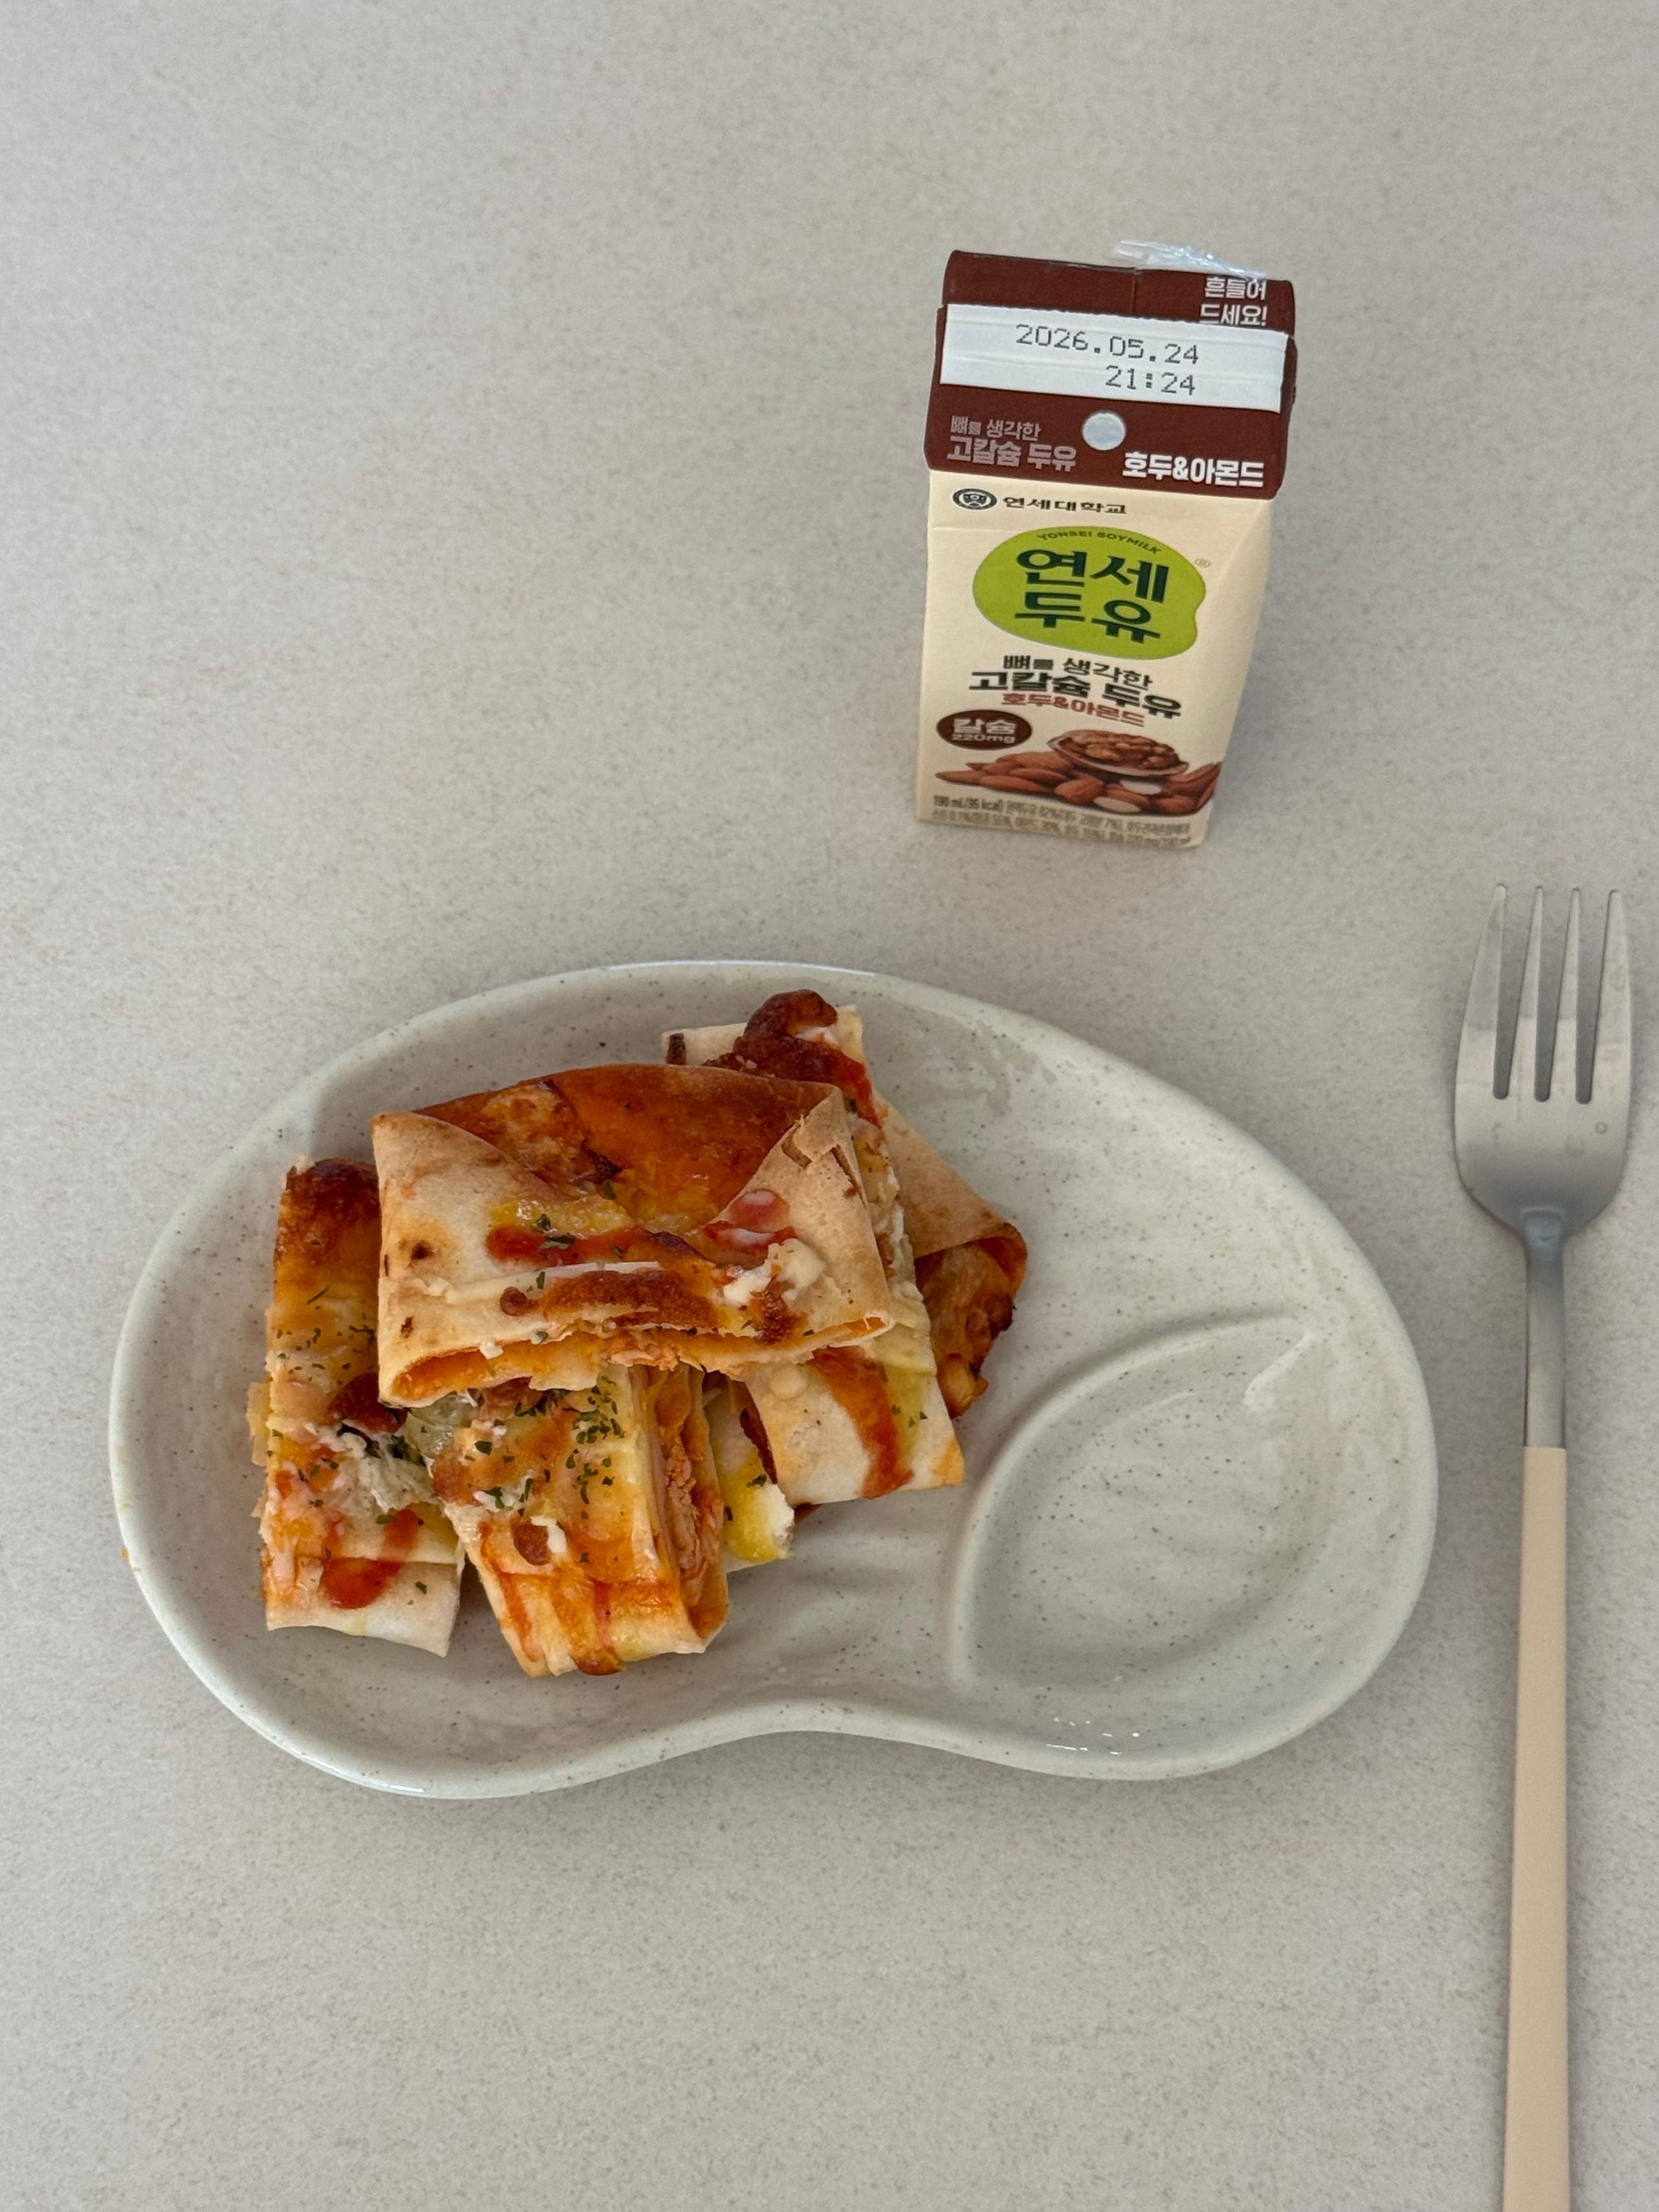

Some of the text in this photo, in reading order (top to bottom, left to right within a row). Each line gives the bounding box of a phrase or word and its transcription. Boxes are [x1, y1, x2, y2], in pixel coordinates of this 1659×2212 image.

[1205, 277, 1266, 301] 흔들어
[1200, 304, 1267, 327] 드세요!
[1016, 323, 1198, 364] 2026.05.24
[1105, 365, 1195, 395] 21:24
[950, 415, 1041, 441] 뼈를 생각한
[947, 436, 1076, 472] 고칼슘 두유
[1122, 452, 1264, 488] 호두&아몬드
[1003, 496, 1126, 514] 연세대학교
[1036, 531, 1162, 555] YONSEI SOYMILK
[1016, 549, 1169, 604] 연세
[1015, 590, 1161, 644] 두유
[1003, 655, 1153, 691] 뼈를 생각한
[969, 671, 1181, 719] 고칼슘 두유
[1001, 693, 1144, 727] 호두&아몬드
[951, 733, 1015, 745] 220mg
[953, 719, 1017, 735] 칼슘
